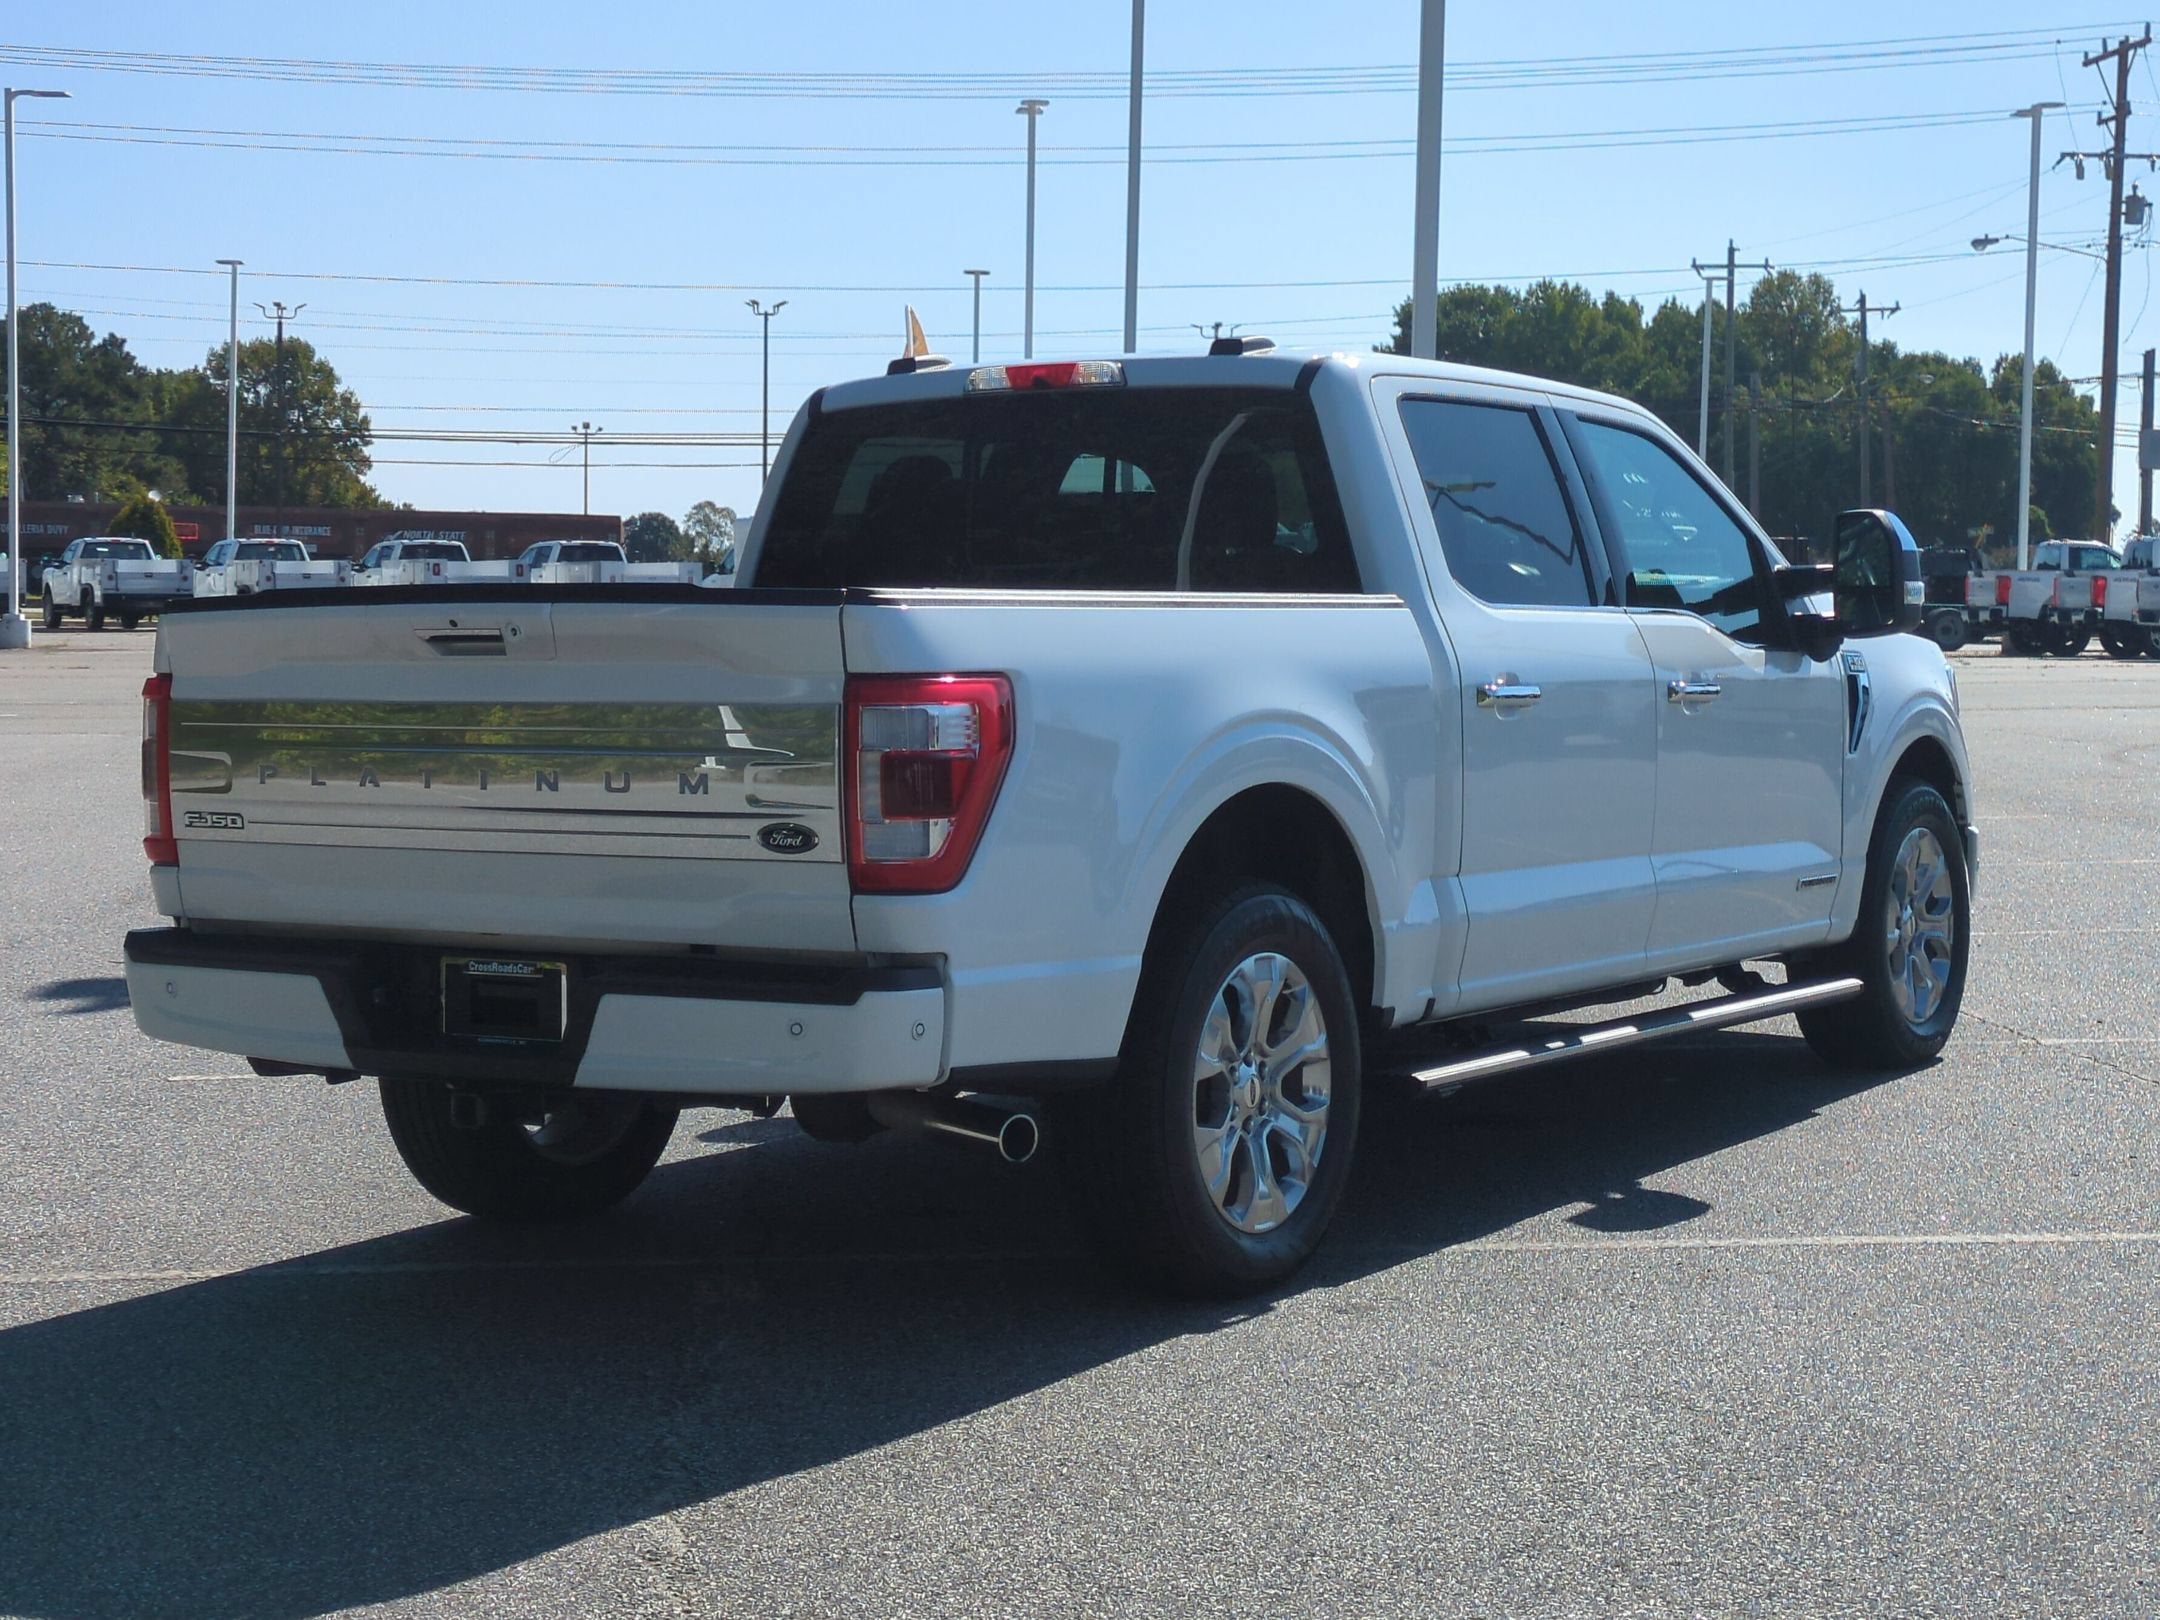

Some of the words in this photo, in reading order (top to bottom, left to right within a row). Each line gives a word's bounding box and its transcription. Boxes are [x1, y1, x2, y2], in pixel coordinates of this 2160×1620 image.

[402, 530, 435, 540] NORTH
[257, 764, 709, 795] PLATINUM
[184, 811, 244, 829] F-150
